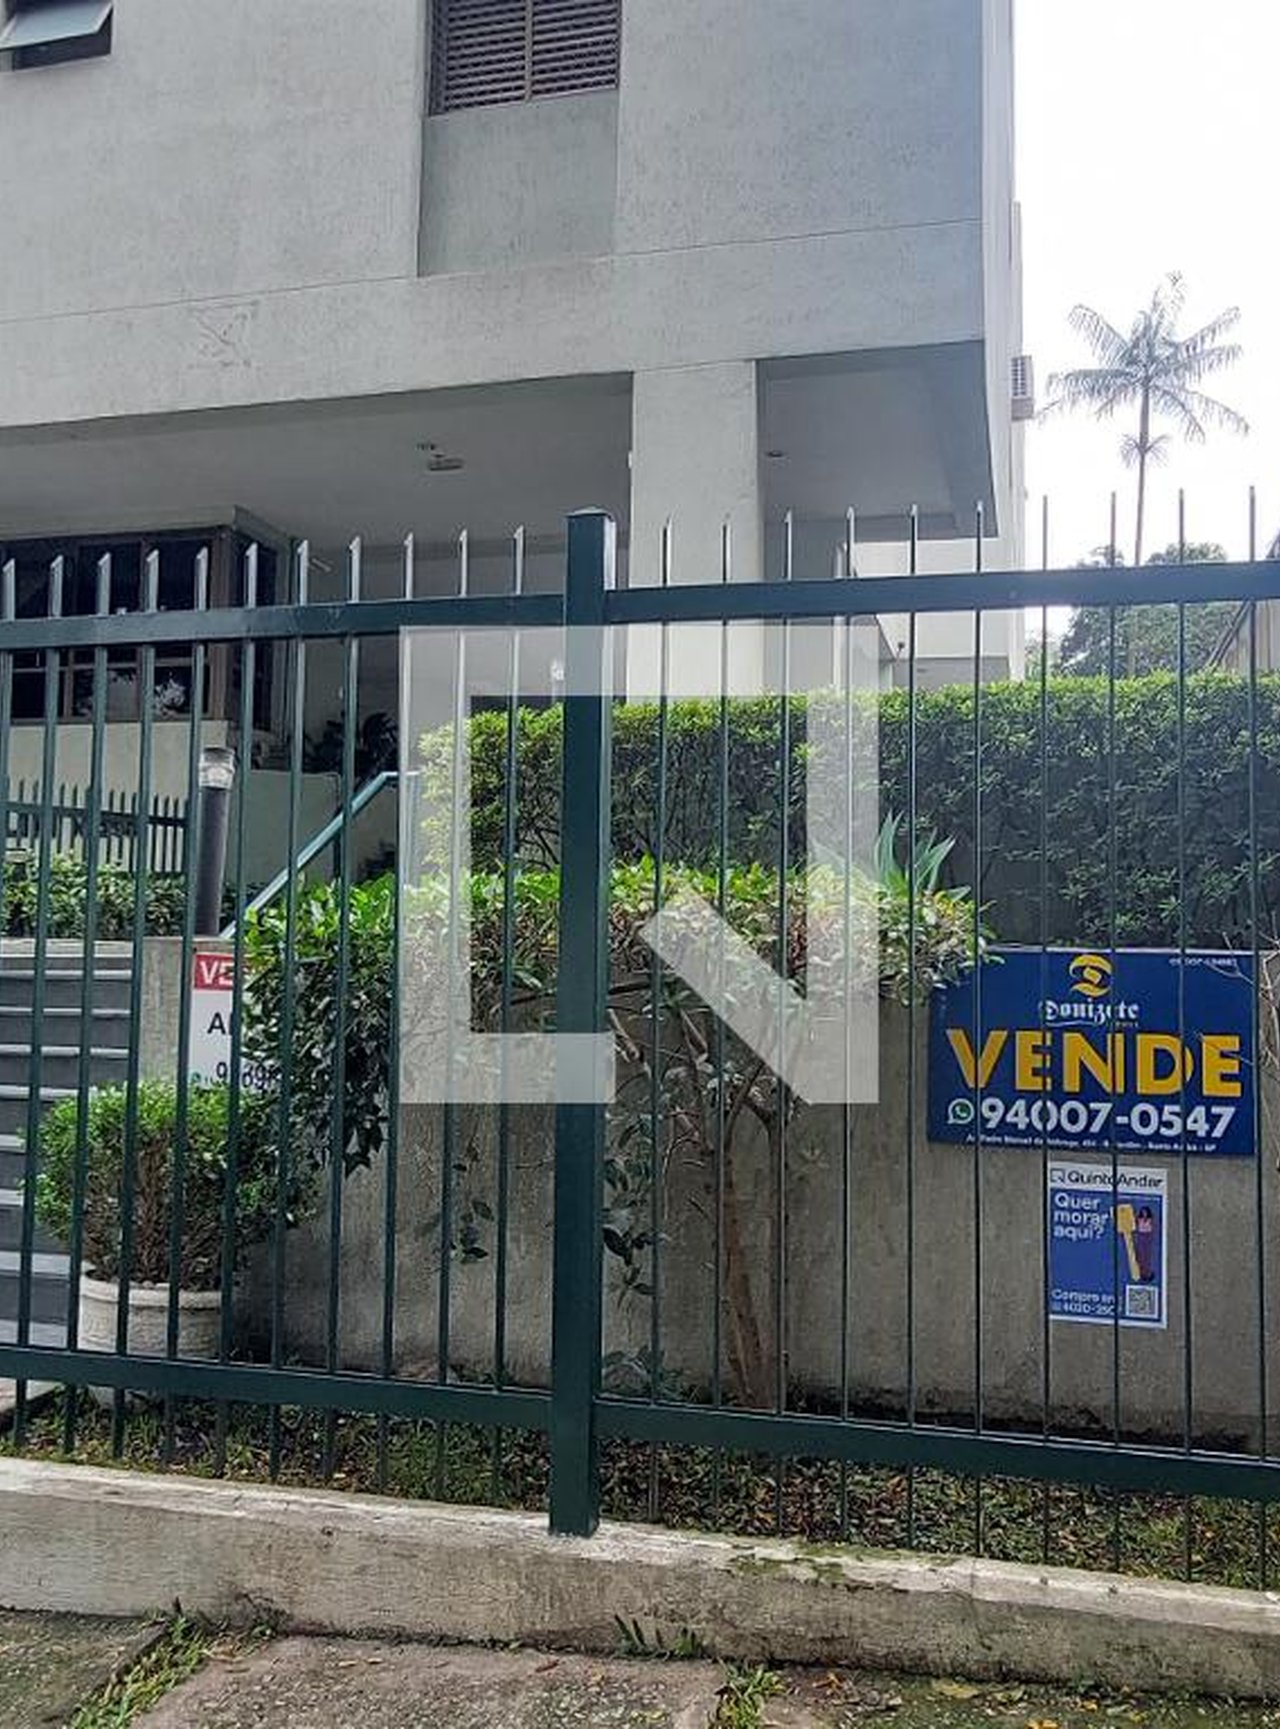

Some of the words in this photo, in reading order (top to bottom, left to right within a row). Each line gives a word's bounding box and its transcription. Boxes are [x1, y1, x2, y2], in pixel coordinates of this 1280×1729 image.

[945, 1028, 1243, 1097] VENDE
[981, 1097, 1236, 1138] 94007-0547
[1054, 1192, 1101, 1210] Quer
[1054, 1210, 1109, 1226] morar
[1054, 1225, 1104, 1241] aqui?
